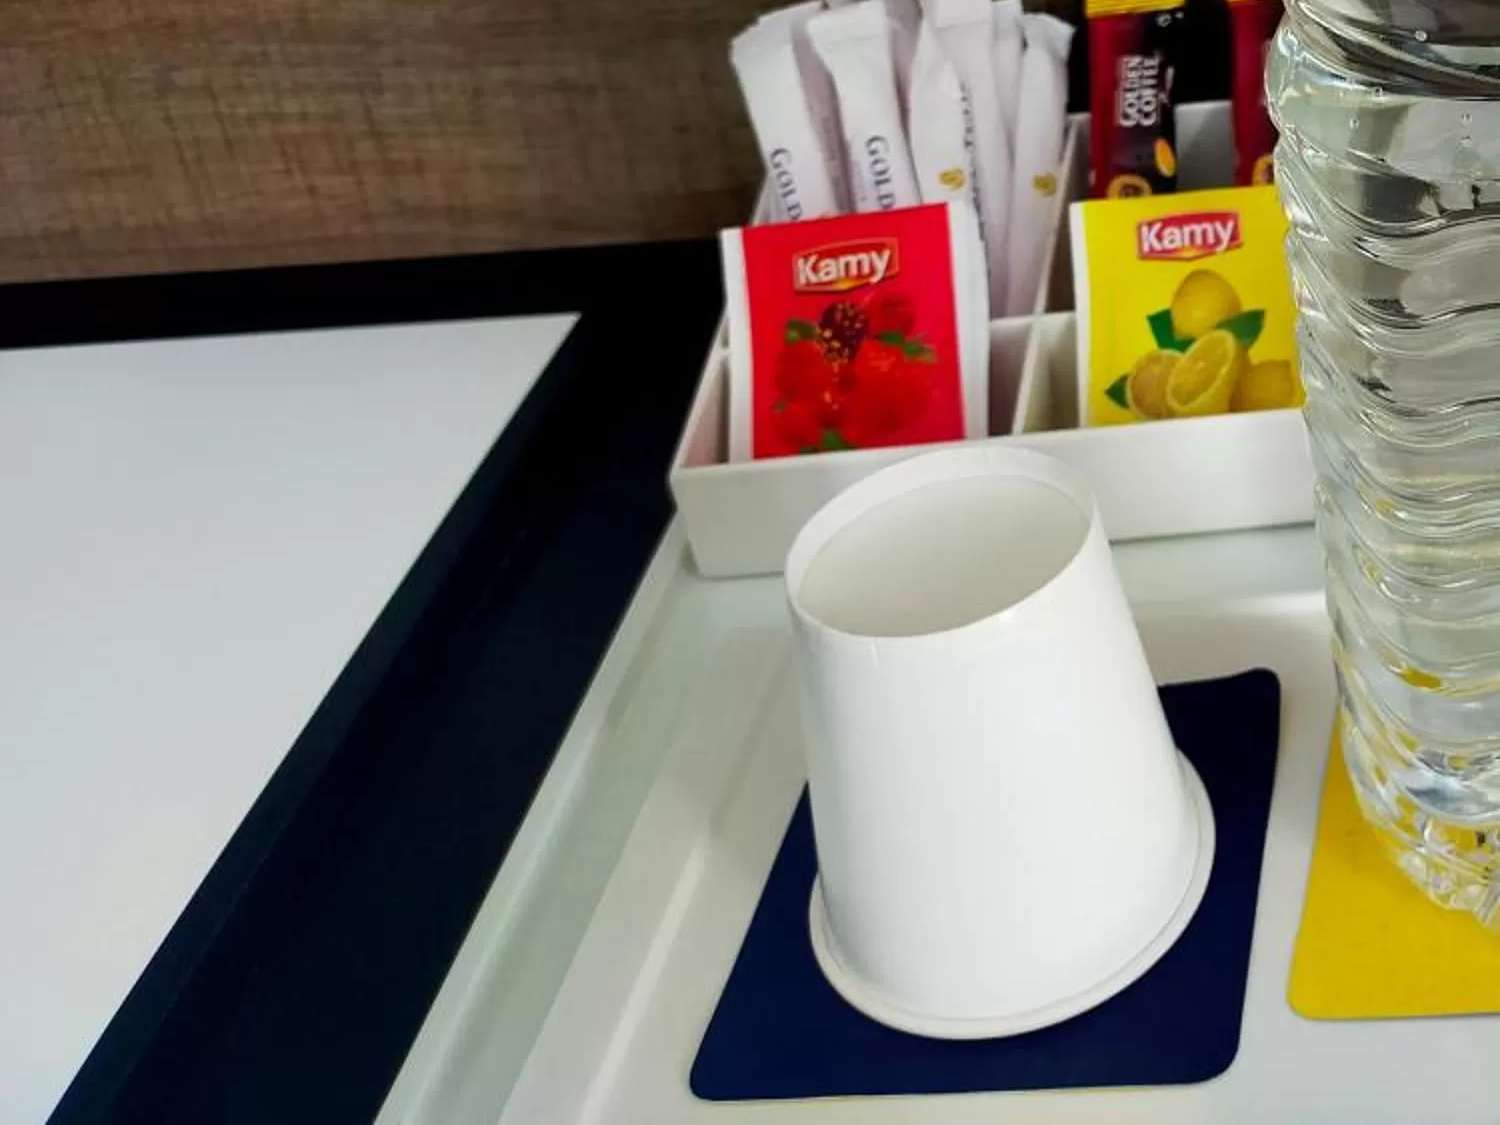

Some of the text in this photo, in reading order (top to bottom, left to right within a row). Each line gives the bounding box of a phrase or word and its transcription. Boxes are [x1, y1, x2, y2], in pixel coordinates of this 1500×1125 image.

[1118, 55, 1142, 127] GOLDEN
[1137, 51, 1161, 127] COFFEE
[770, 147, 803, 220] GOLD
[865, 135, 896, 210] GOLD
[796, 248, 892, 284] Kamy
[1139, 219, 1235, 255] Kamy
